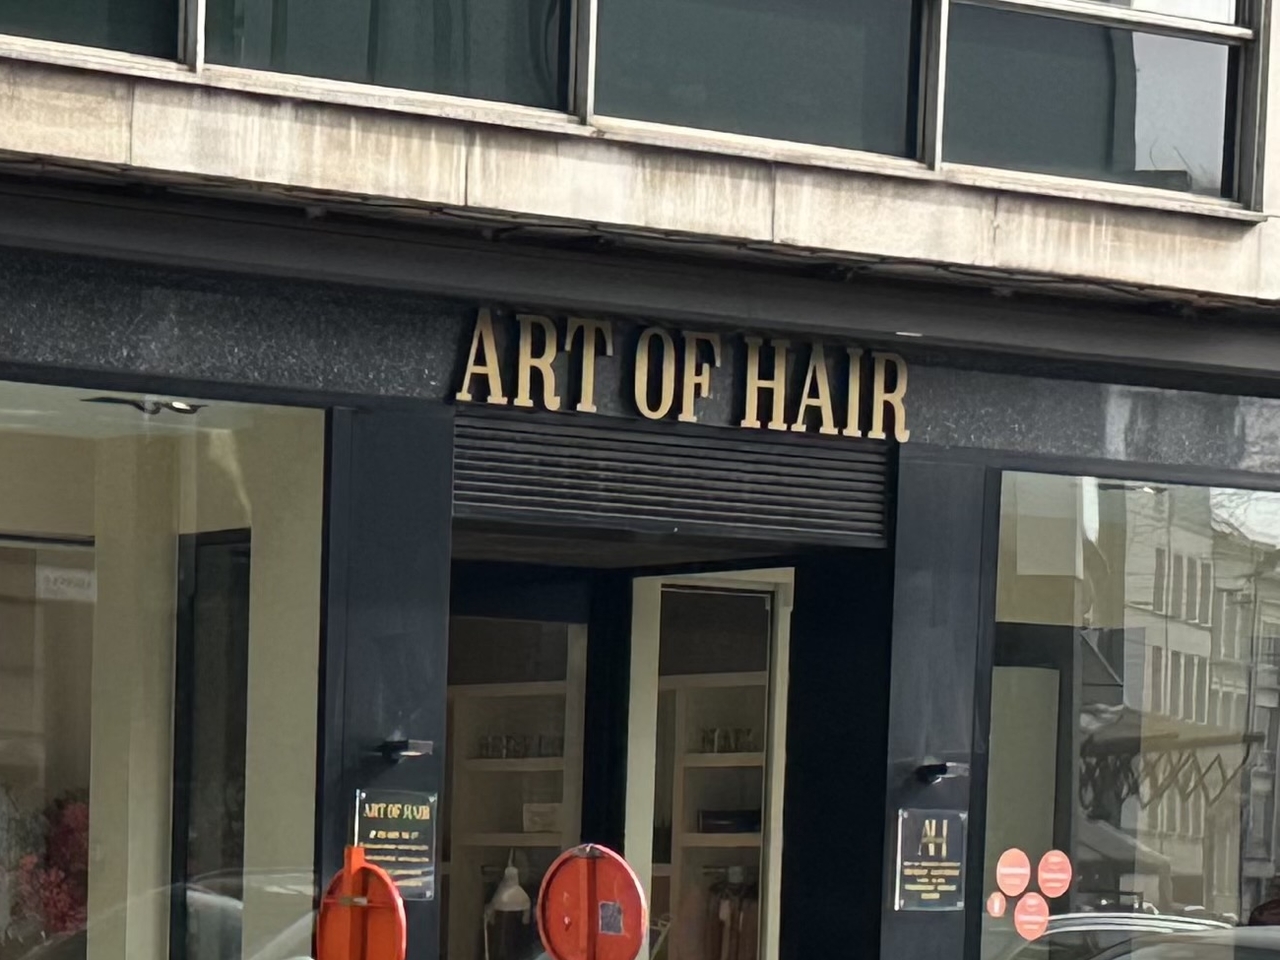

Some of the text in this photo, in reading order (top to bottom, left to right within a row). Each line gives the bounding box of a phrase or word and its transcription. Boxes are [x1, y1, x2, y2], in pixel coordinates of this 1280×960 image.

[455, 307, 910, 443] ART OF HAIR
